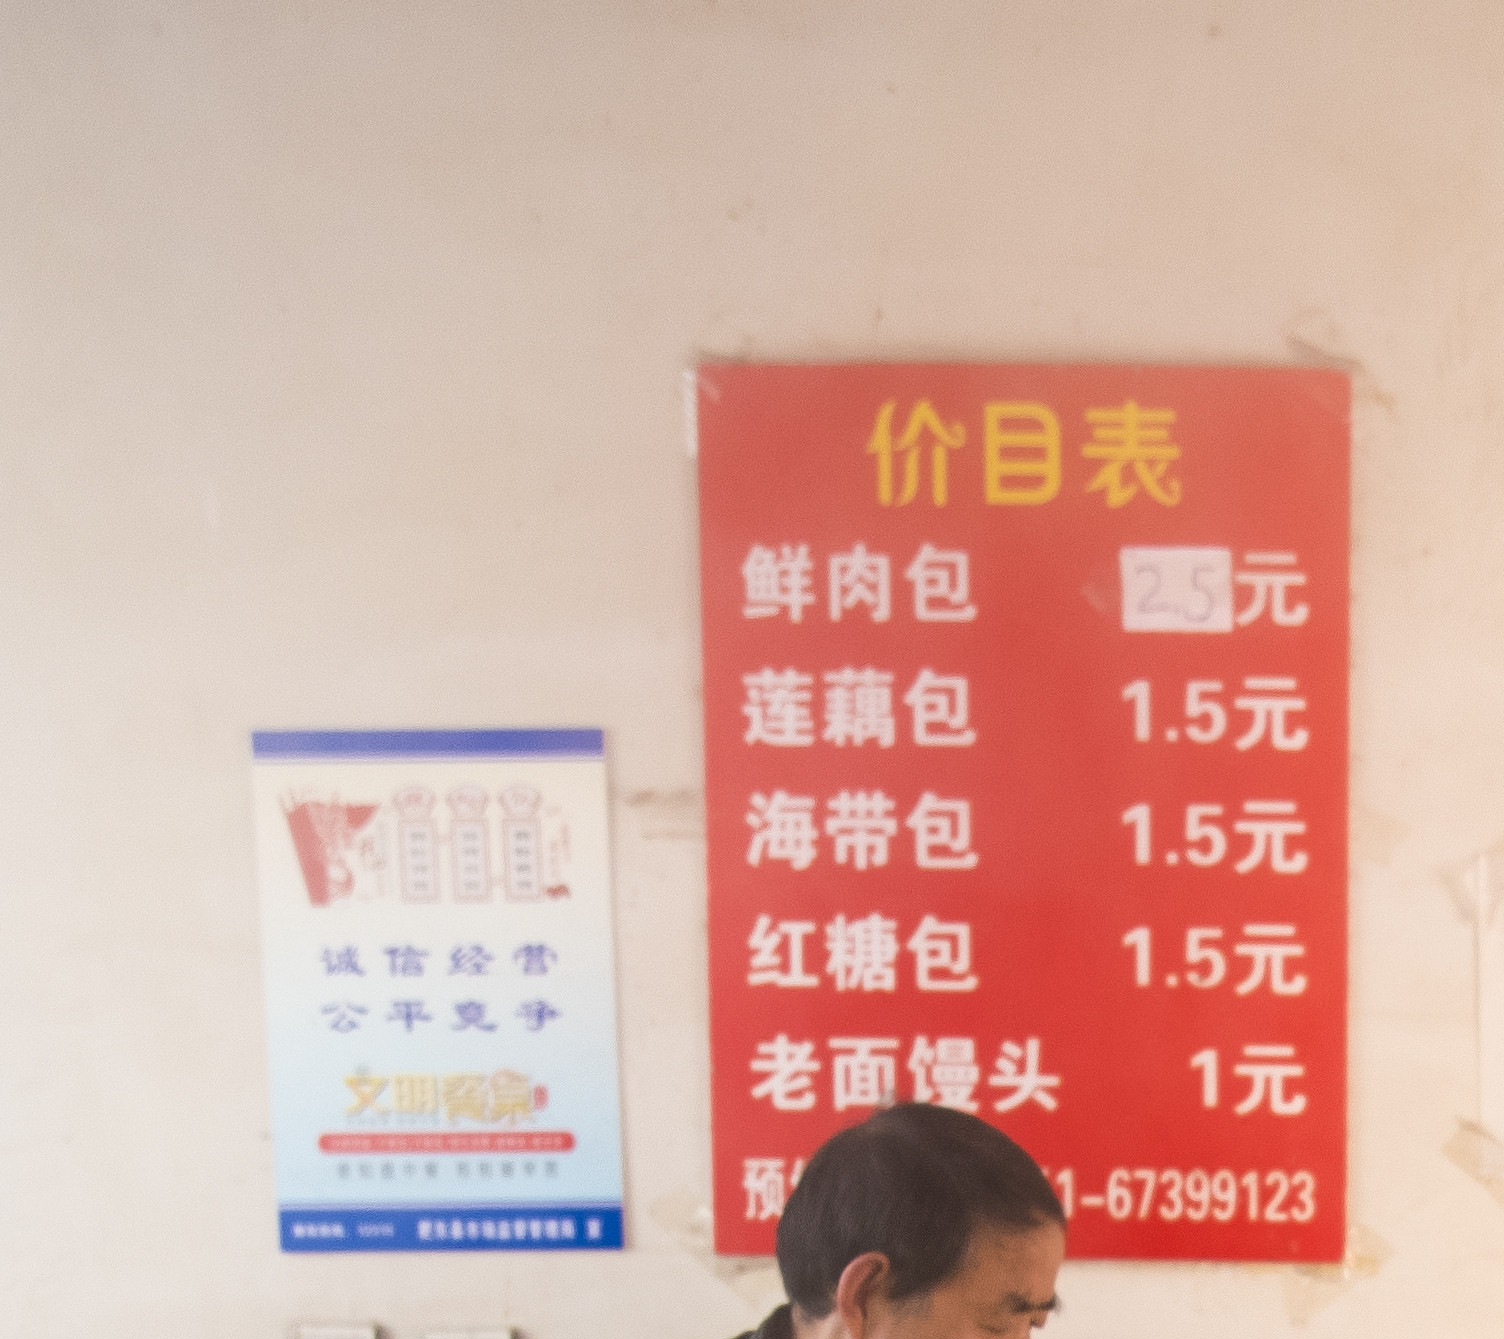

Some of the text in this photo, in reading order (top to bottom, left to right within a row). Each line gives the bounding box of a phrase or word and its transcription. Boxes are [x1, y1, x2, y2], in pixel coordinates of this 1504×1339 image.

[865, 399, 1183, 507] 价目表
[742, 543, 978, 623] 鲜肉包
[742, 668, 1309, 751] 莲藕包 1.5元
[746, 791, 1308, 873] 海带包 1.5元
[320, 943, 558, 977] 诚信经营
[747, 913, 1308, 996] 红糖包 1.5元
[320, 999, 562, 1033] 公平竞争
[749, 1034, 1307, 1115] 老面馒头 1元
